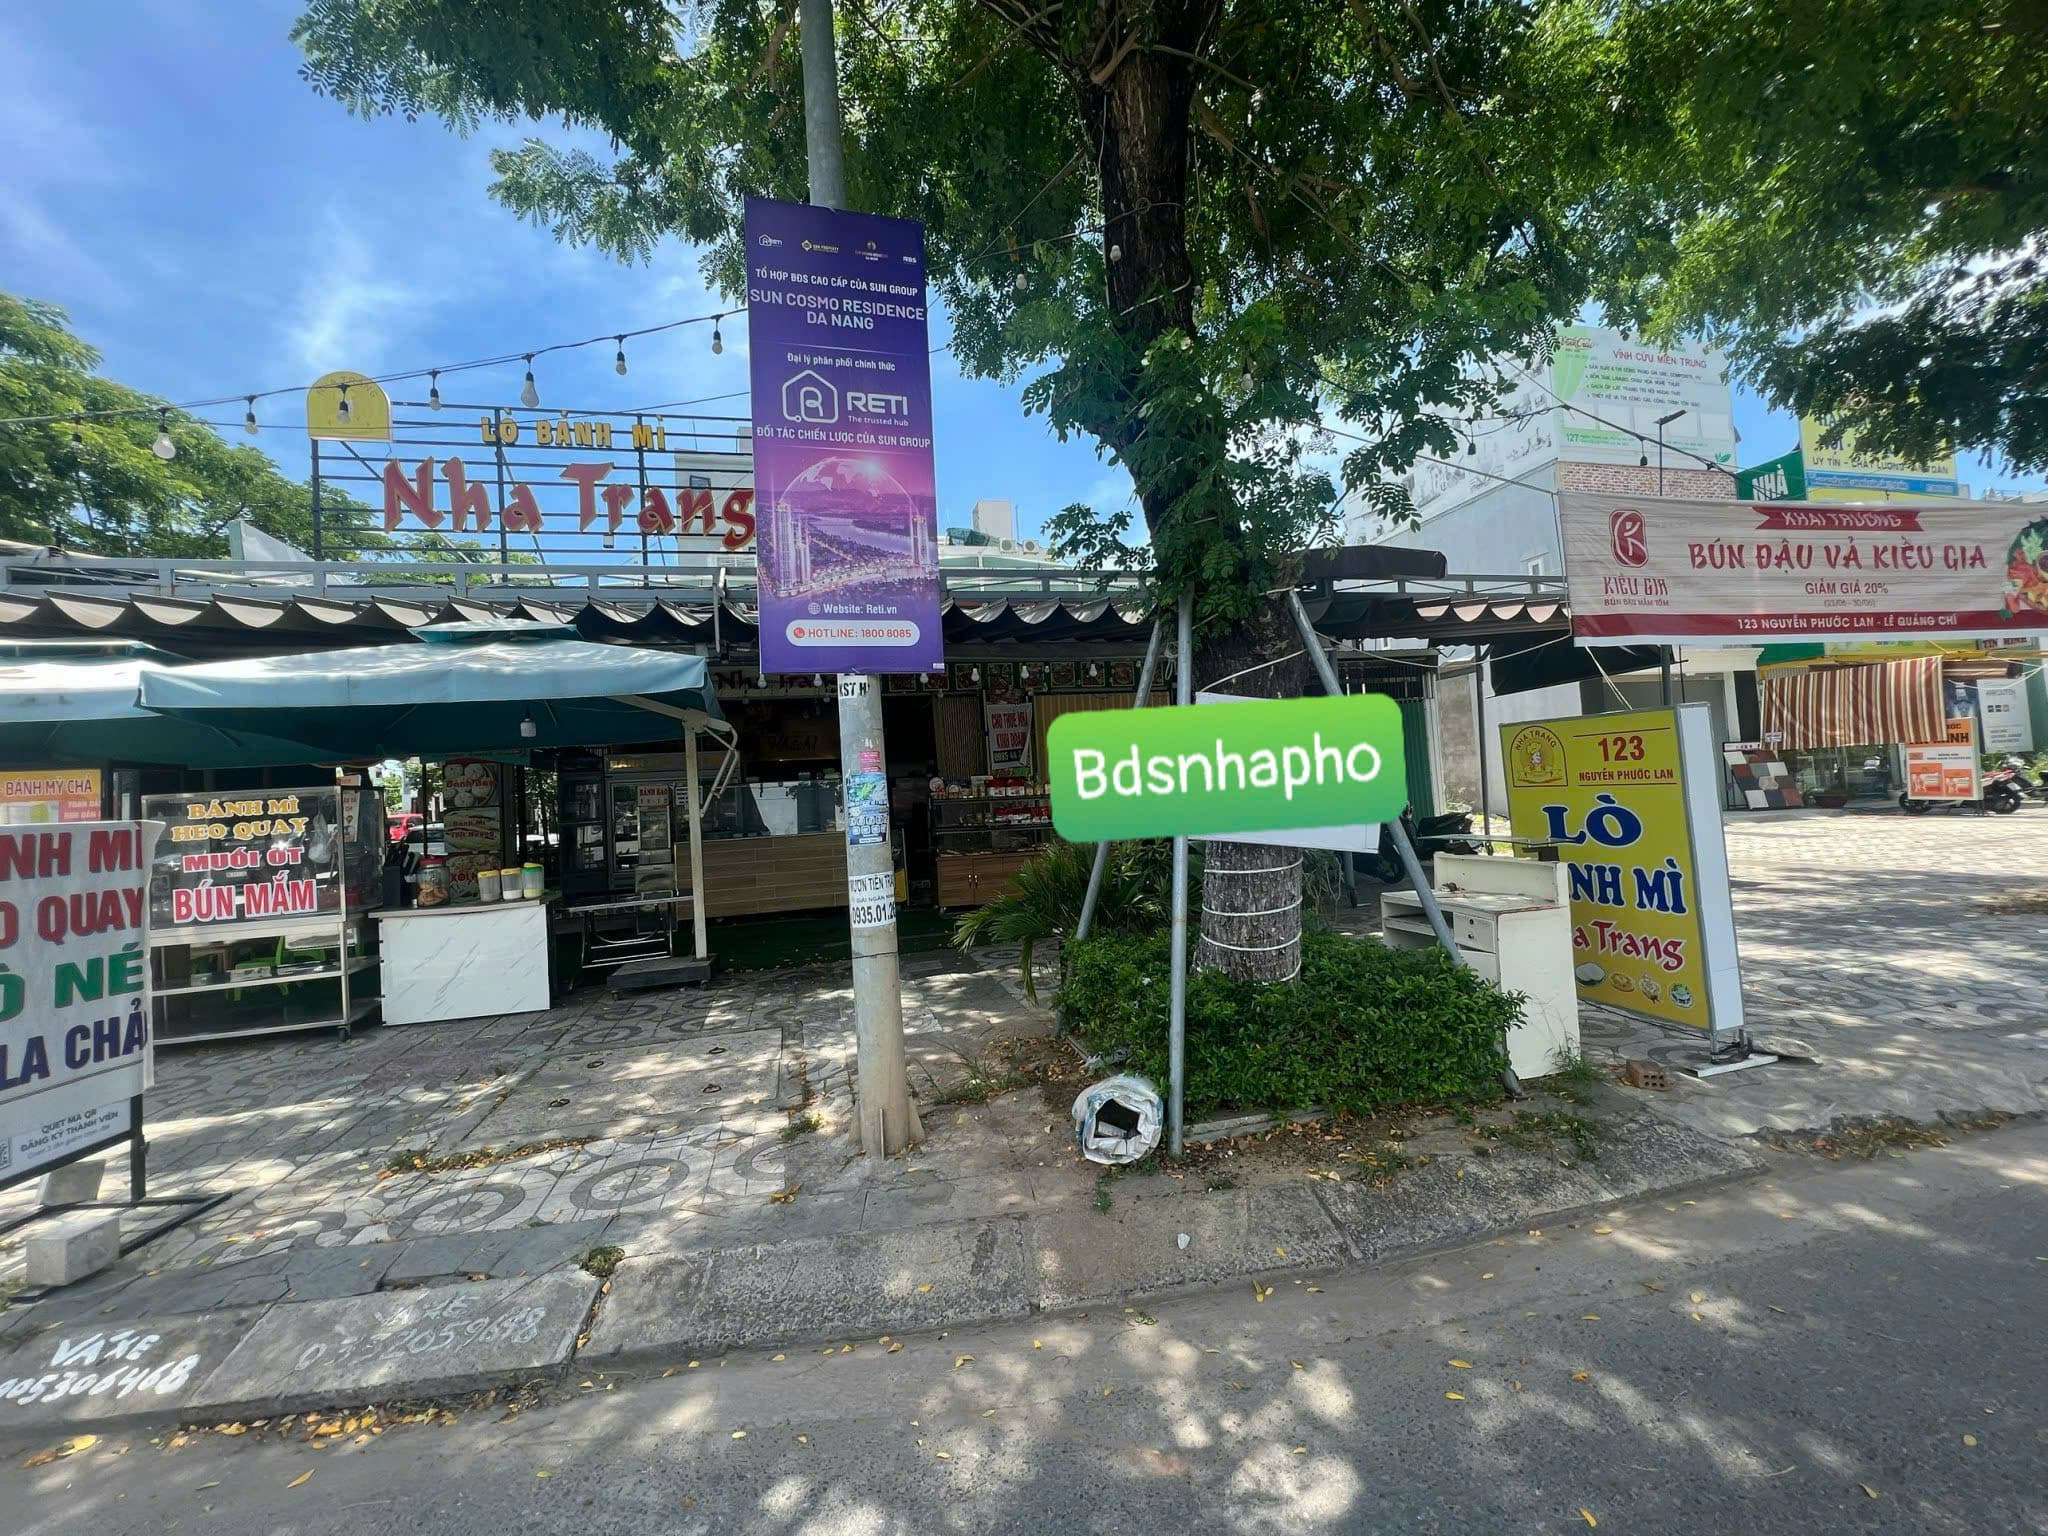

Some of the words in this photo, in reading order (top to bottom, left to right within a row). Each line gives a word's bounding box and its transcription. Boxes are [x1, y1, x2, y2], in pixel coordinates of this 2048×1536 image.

[755, 266, 768, 278] TỔ
[770, 270, 789, 282] HỢP
[810, 275, 828, 286] CAO
[831, 276, 848, 288] CẤP
[850, 278, 867, 290] CỦA
[869, 282, 887, 292] SUN
[890, 284, 918, 296] GROUP
[750, 288, 783, 305] SUN
[786, 293, 840, 311] COSMO
[843, 300, 925, 321] RESIDENCE
[807, 311, 828, 326] DA
[831, 313, 874, 330] NANG
[787, 352, 801, 364] Đại
[804, 354, 811, 365] lý
[813, 355, 834, 366] phân
[836, 357, 853, 368] phối
[878, 361, 896, 372] thức
[1679, 357, 1708, 369] TRUNG
[846, 391, 909, 416] RETI
[481, 408, 519, 445] LÒ
[536, 409, 613, 448] BÁNH
[631, 414, 666, 450] MÌ
[848, 415, 863, 424] The
[864, 416, 891, 425] trusted
[894, 417, 909, 427] hub
[756, 424, 774, 438] ĐỐI
[777, 426, 796, 439] TÁC
[798, 427, 827, 442] CHIẾN
[830, 431, 855, 444] LƯỢC
[857, 430, 876, 444] CỦA
[878, 435, 898, 446] SUN
[900, 436, 931, 448] GROUP
[1752, 462, 1789, 501] NHÀ
[383, 456, 544, 534] Nha
[559, 462, 757, 552] Trang
[1781, 511, 1826, 526] KHAI
[1688, 537, 1746, 570] BÚN
[1755, 538, 1813, 574] ĐẬU
[1872, 535, 1934, 570] KIỀU
[1943, 544, 1988, 571] GIA
[1603, 572, 1638, 596] KIỀU
[1644, 577, 1668, 596] GIA
[1804, 578, 1837, 595] GIẢM
[1864, 582, 1889, 594] 20%
[823, 604, 864, 614] Website:
[866, 604, 897, 615] Reti.vn
[1737, 618, 1758, 630] 123
[1761, 614, 1808, 629] NGUYỄN
[1810, 614, 1850, 628] PHƯỚC
[1854, 616, 1875, 628] LAN
[1884, 614, 1896, 626] LÊ
[1938, 612, 1958, 626] CHÍ
[808, 628, 858, 639] HOTLINE:
[860, 628, 884, 639] 1800
[886, 628, 912, 639] 8085
[1598, 735, 1645, 762] 123
[6, 778, 41, 796] BÁNH
[1579, 768, 1614, 782] NGUYỄN
[1654, 768, 1674, 780] LAN
[187, 798, 264, 820] BÁNH
[268, 794, 300, 815] MÌ
[1541, 792, 1643, 847] LÒ
[171, 822, 227, 842] HEO
[233, 816, 310, 841] QUAY
[89, 821, 144, 873] MÌ
[182, 846, 260, 873] MUỐI
[172, 878, 236, 923] BÚN
[244, 870, 318, 918] MẮM
[1568, 862, 1625, 907] NH
[1632, 857, 1687, 915] MÌ
[37, 886, 145, 946] QUAY
[1590, 919, 1685, 972] Trang
[54, 941, 144, 1009] NÉ
[65, 997, 147, 1070] CHẢ
